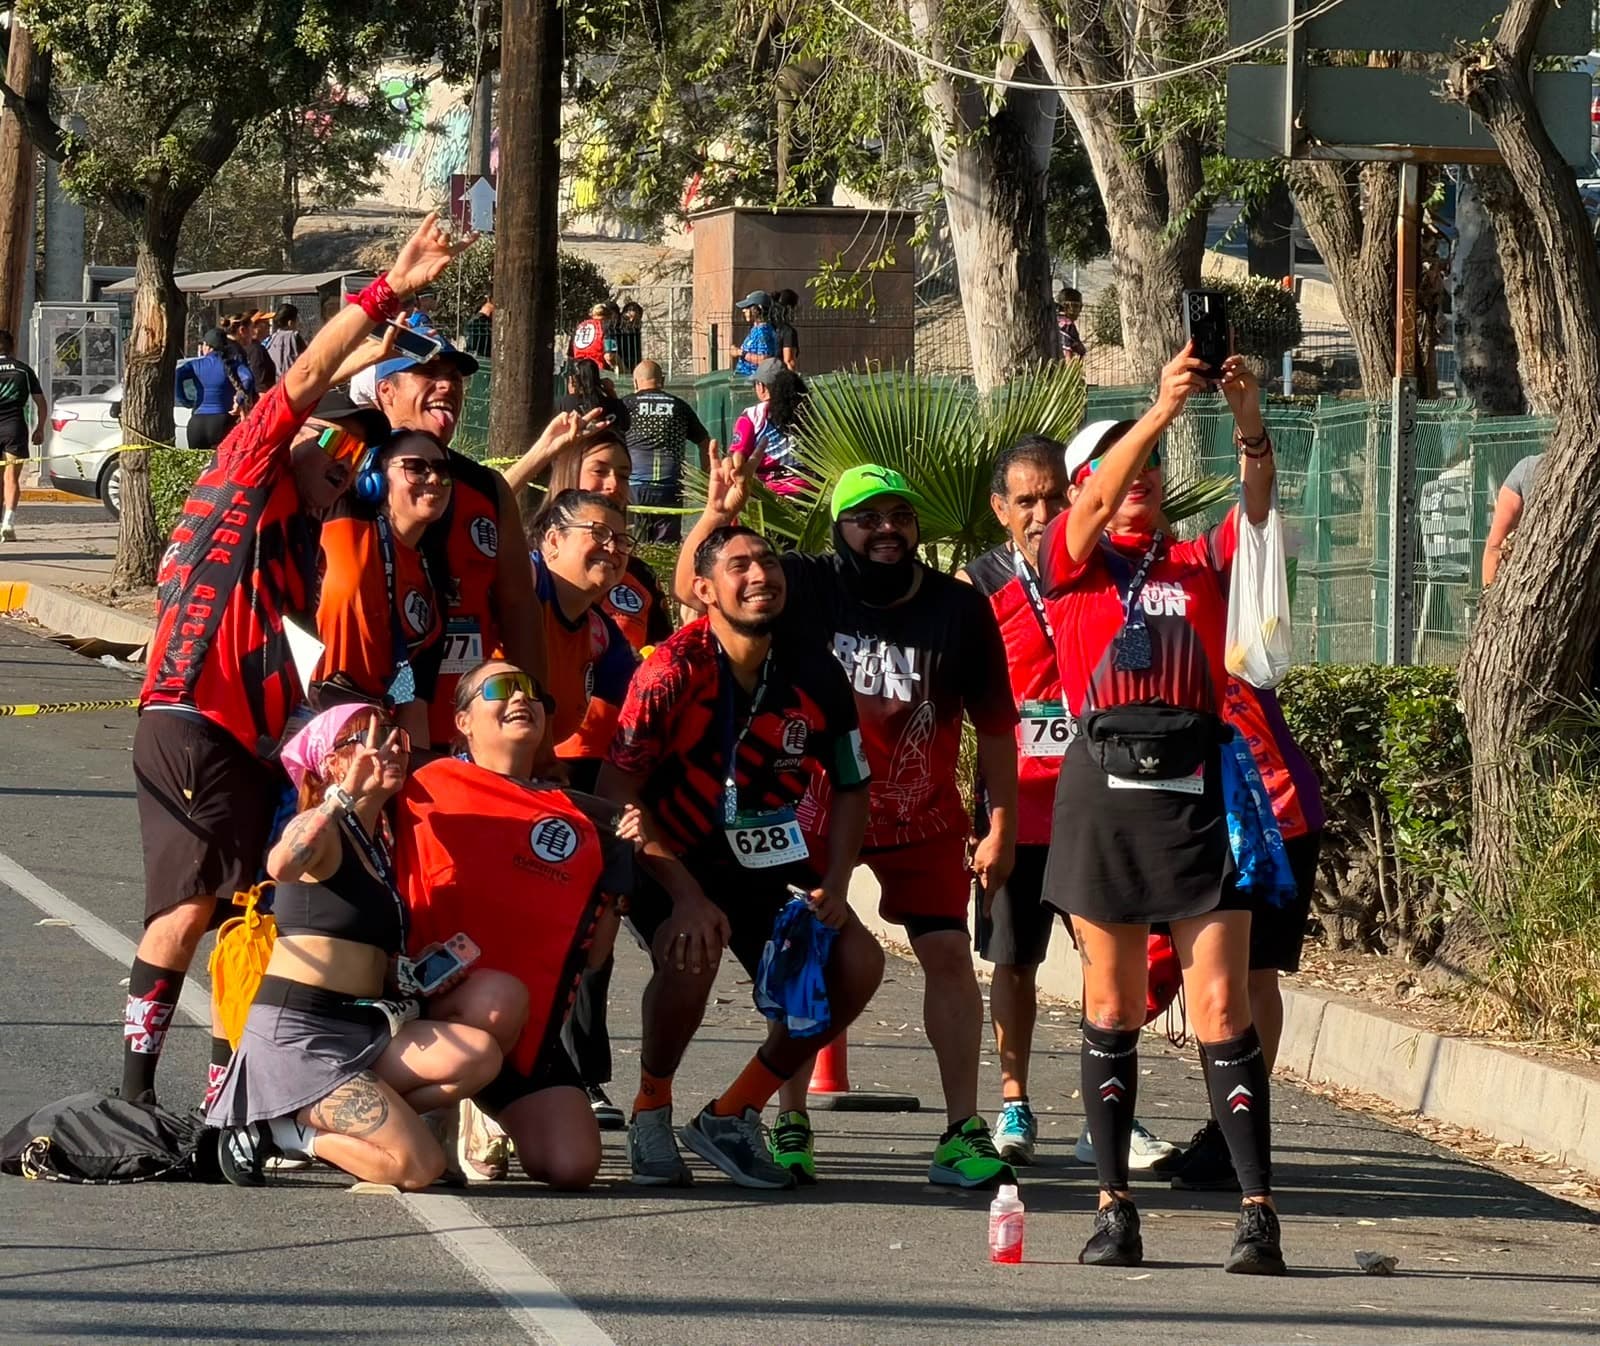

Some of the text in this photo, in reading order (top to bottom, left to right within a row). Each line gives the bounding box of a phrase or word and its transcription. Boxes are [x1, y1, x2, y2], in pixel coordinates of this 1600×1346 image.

[638, 402, 674, 416] ALEX
[206, 490, 250, 565] LOMA
[1141, 597, 1187, 616] UN
[848, 663, 912, 702] UN
[735, 826, 789, 855] 628
